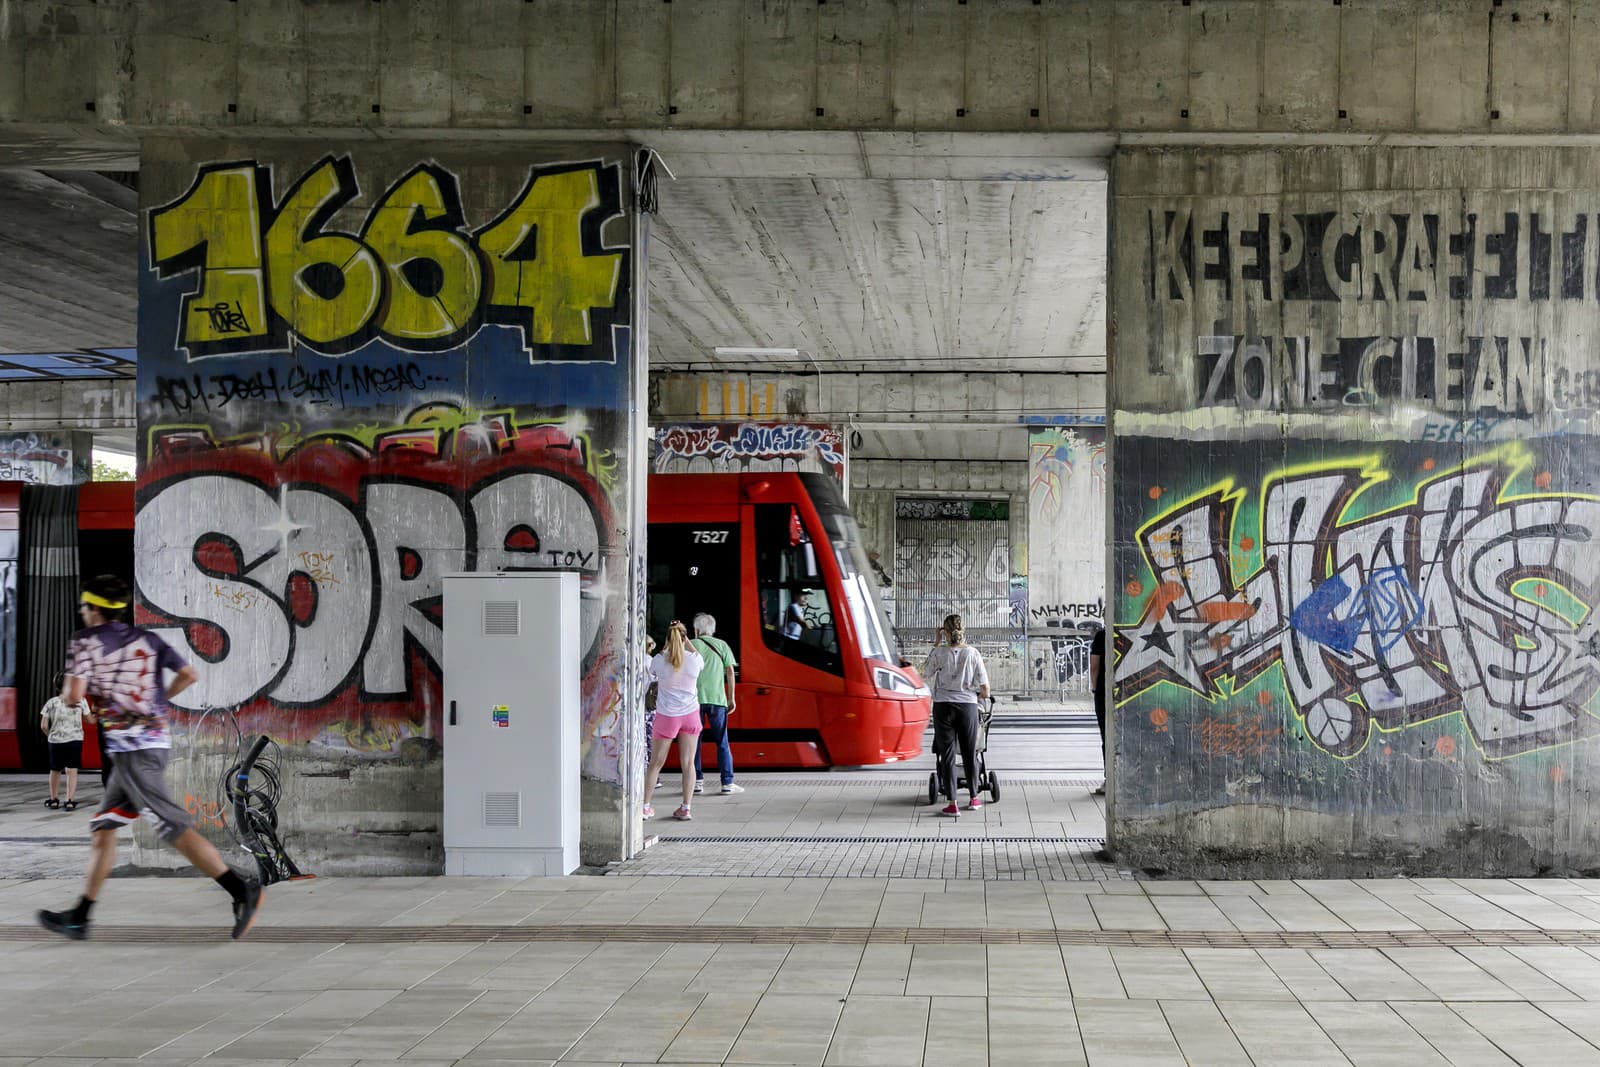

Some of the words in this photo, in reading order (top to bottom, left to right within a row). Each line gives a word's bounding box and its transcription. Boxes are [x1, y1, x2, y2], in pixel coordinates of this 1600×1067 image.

[149, 150, 630, 364] 1664
[1148, 210, 1306, 301] KEEP
[1198, 335, 1337, 404] ZONE
[1357, 336, 1544, 411] CLEAN
[546, 549, 593, 567] TOY
[691, 531, 729, 543] 7527
